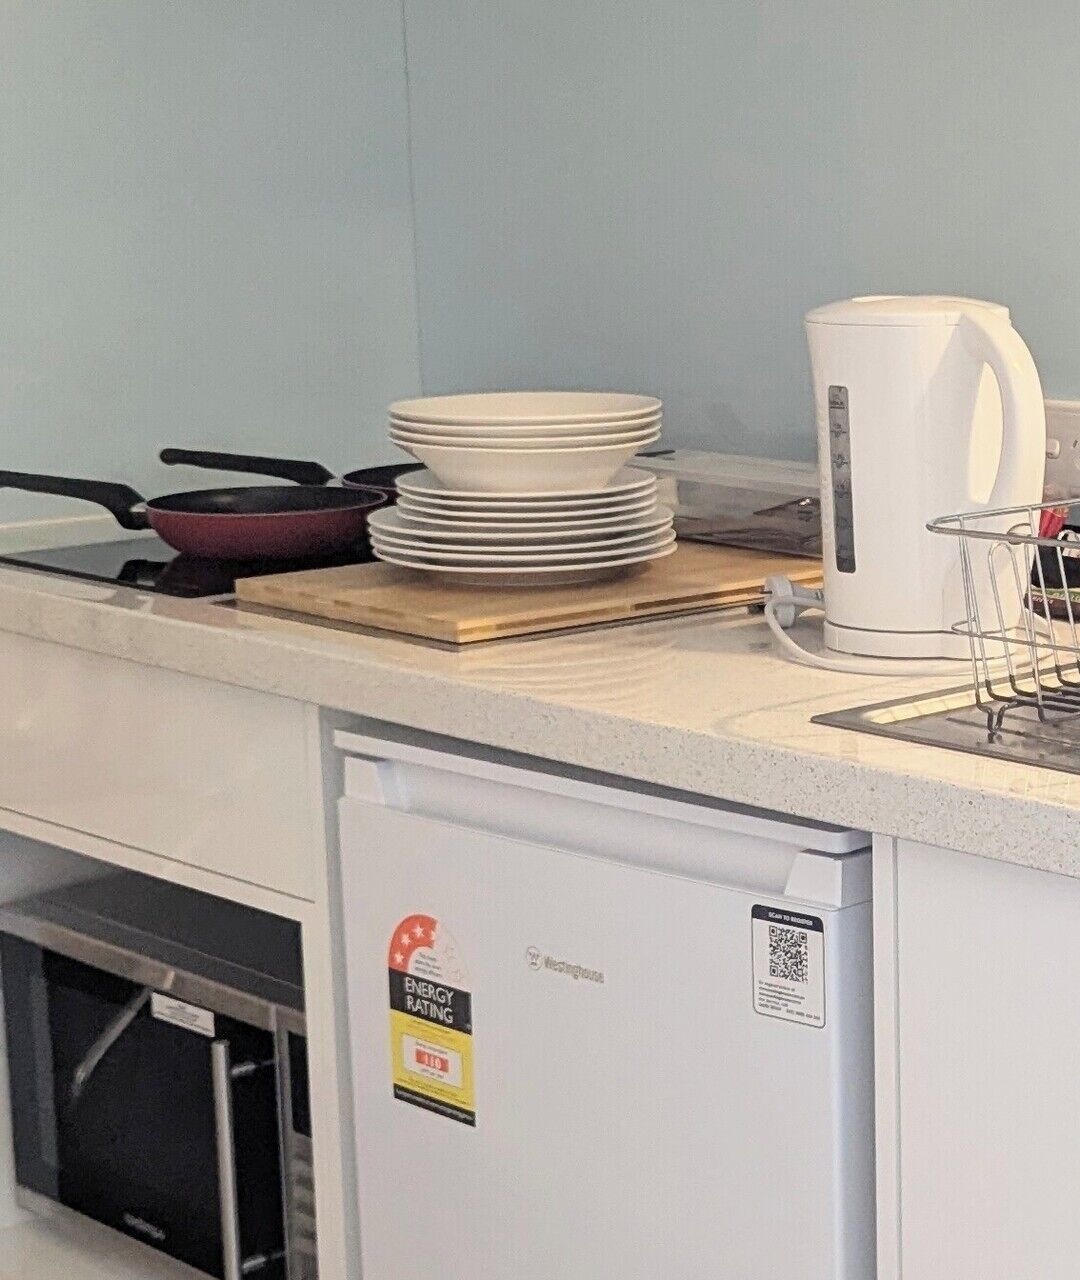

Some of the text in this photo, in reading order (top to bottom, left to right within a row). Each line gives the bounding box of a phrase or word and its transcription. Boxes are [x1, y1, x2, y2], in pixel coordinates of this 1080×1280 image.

[768, 911, 782, 920] SCAN
[543, 956, 604, 983] Westinghouse
[405, 976, 454, 1006] ENERGY
[406, 994, 454, 1024] RATING
